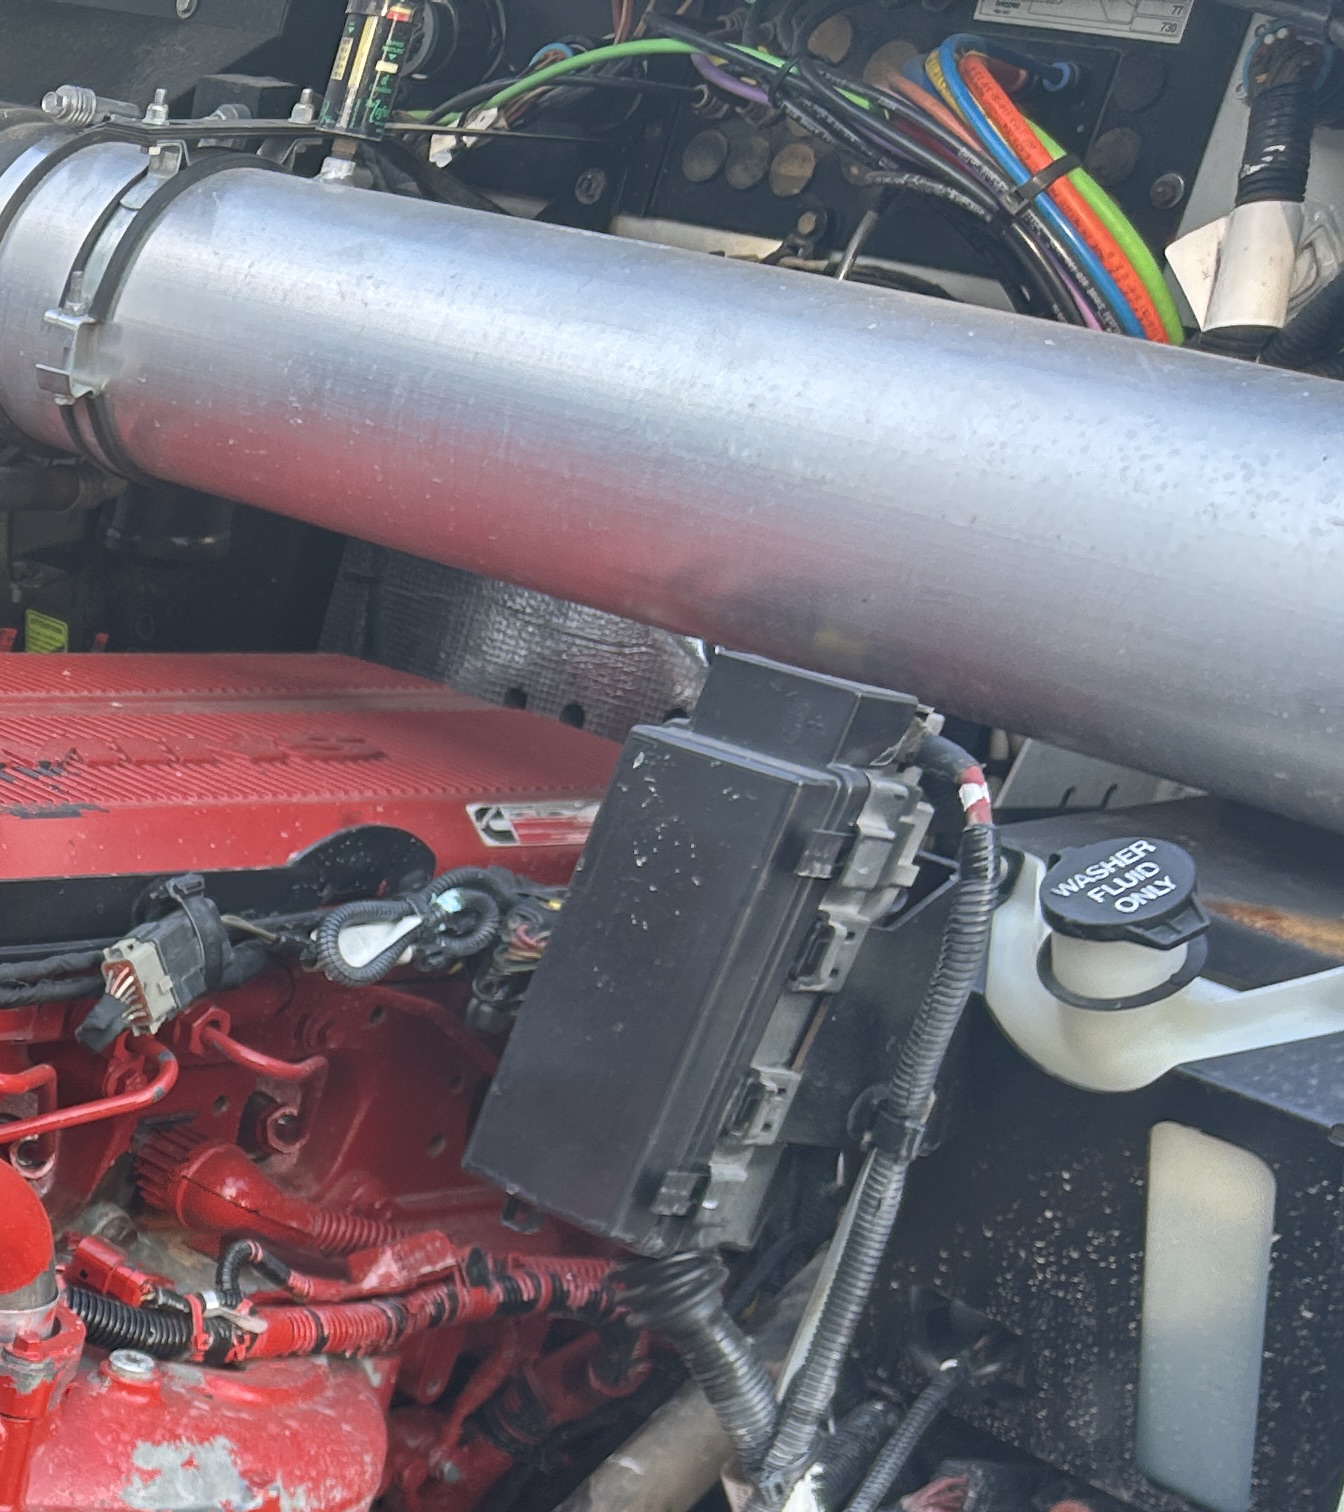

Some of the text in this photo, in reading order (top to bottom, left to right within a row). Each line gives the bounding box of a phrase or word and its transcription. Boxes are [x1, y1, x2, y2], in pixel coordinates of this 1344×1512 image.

[1050, 839, 1157, 897] WASHER
[1086, 861, 1161, 903] FLUID
[1114, 875, 1177, 913] ONLY
